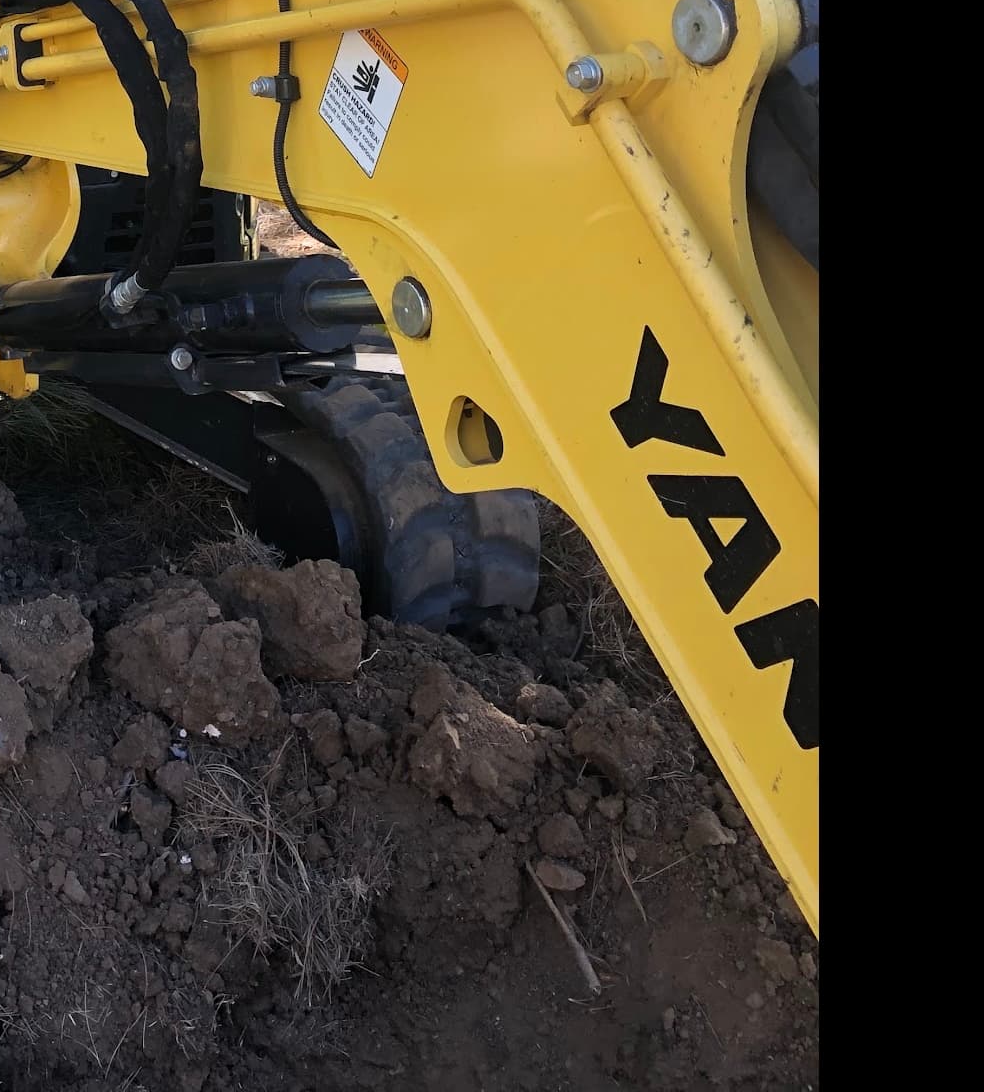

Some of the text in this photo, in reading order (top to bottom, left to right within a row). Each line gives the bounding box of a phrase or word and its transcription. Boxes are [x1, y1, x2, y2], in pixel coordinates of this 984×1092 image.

[365, 28, 398, 70] WARNING
[330, 80, 380, 146] STAY CLEAR OF AREA!
[332, 72, 376, 127] CRUSH HAZARD!
[341, 107, 347, 116] to
[346, 114, 363, 136] comply
[362, 134, 376, 152] could
